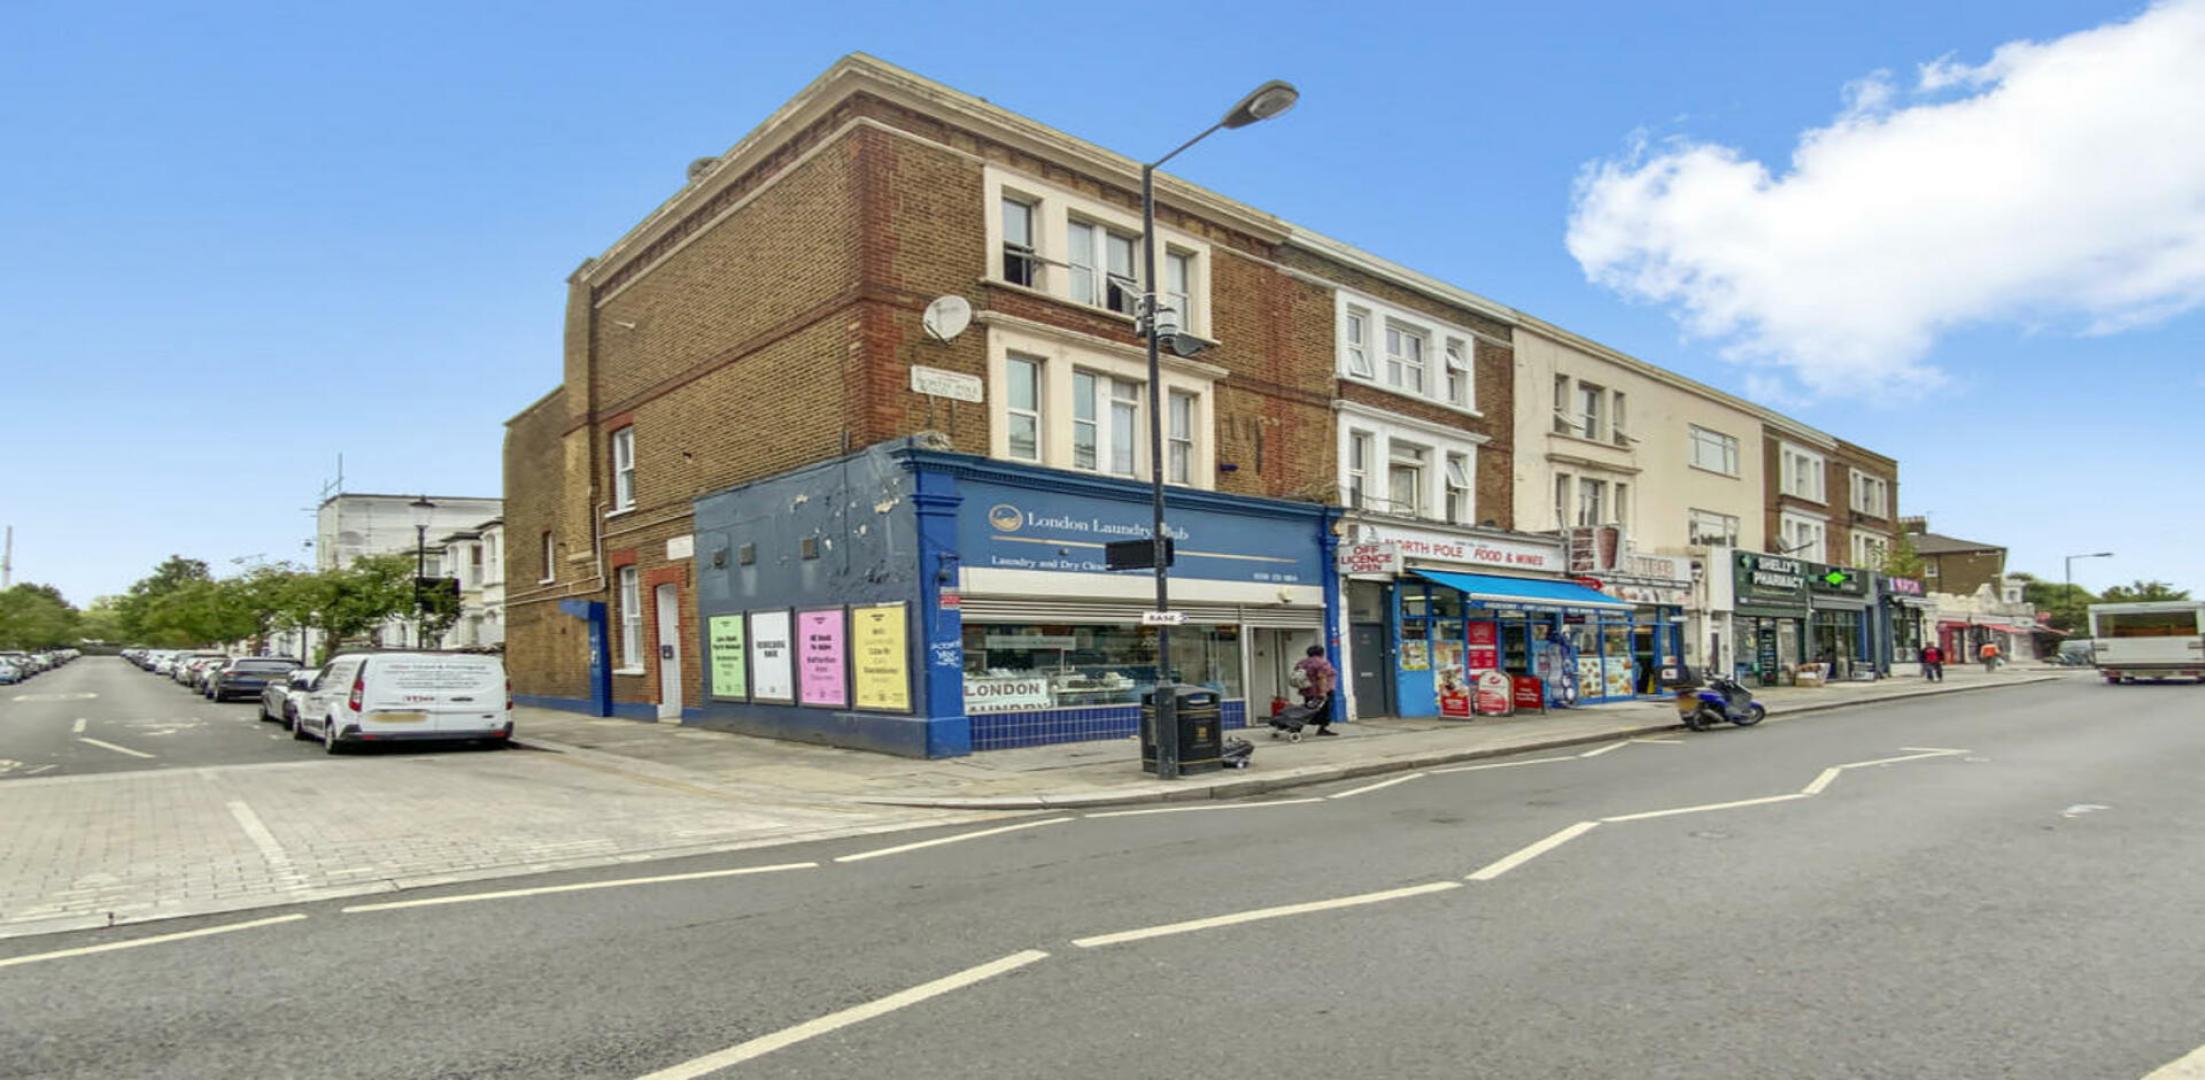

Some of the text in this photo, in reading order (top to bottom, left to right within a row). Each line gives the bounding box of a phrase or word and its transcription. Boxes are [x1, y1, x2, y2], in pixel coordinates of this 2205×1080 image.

[1028, 512, 1190, 540] London Laundry ub
[1353, 545, 1379, 555] OFF
[1433, 543, 1464, 558] POLE
[1473, 548, 1502, 562] FOOD
[1505, 552, 1513, 563] &
[992, 555, 1036, 569] Laundry
[1060, 559, 1080, 572] Dry
[1341, 554, 1392, 565] LICENCE
[1352, 562, 1382, 572] OPEN
[1753, 571, 1805, 589] PHARMACY
[963, 683, 1041, 698] LONDON
